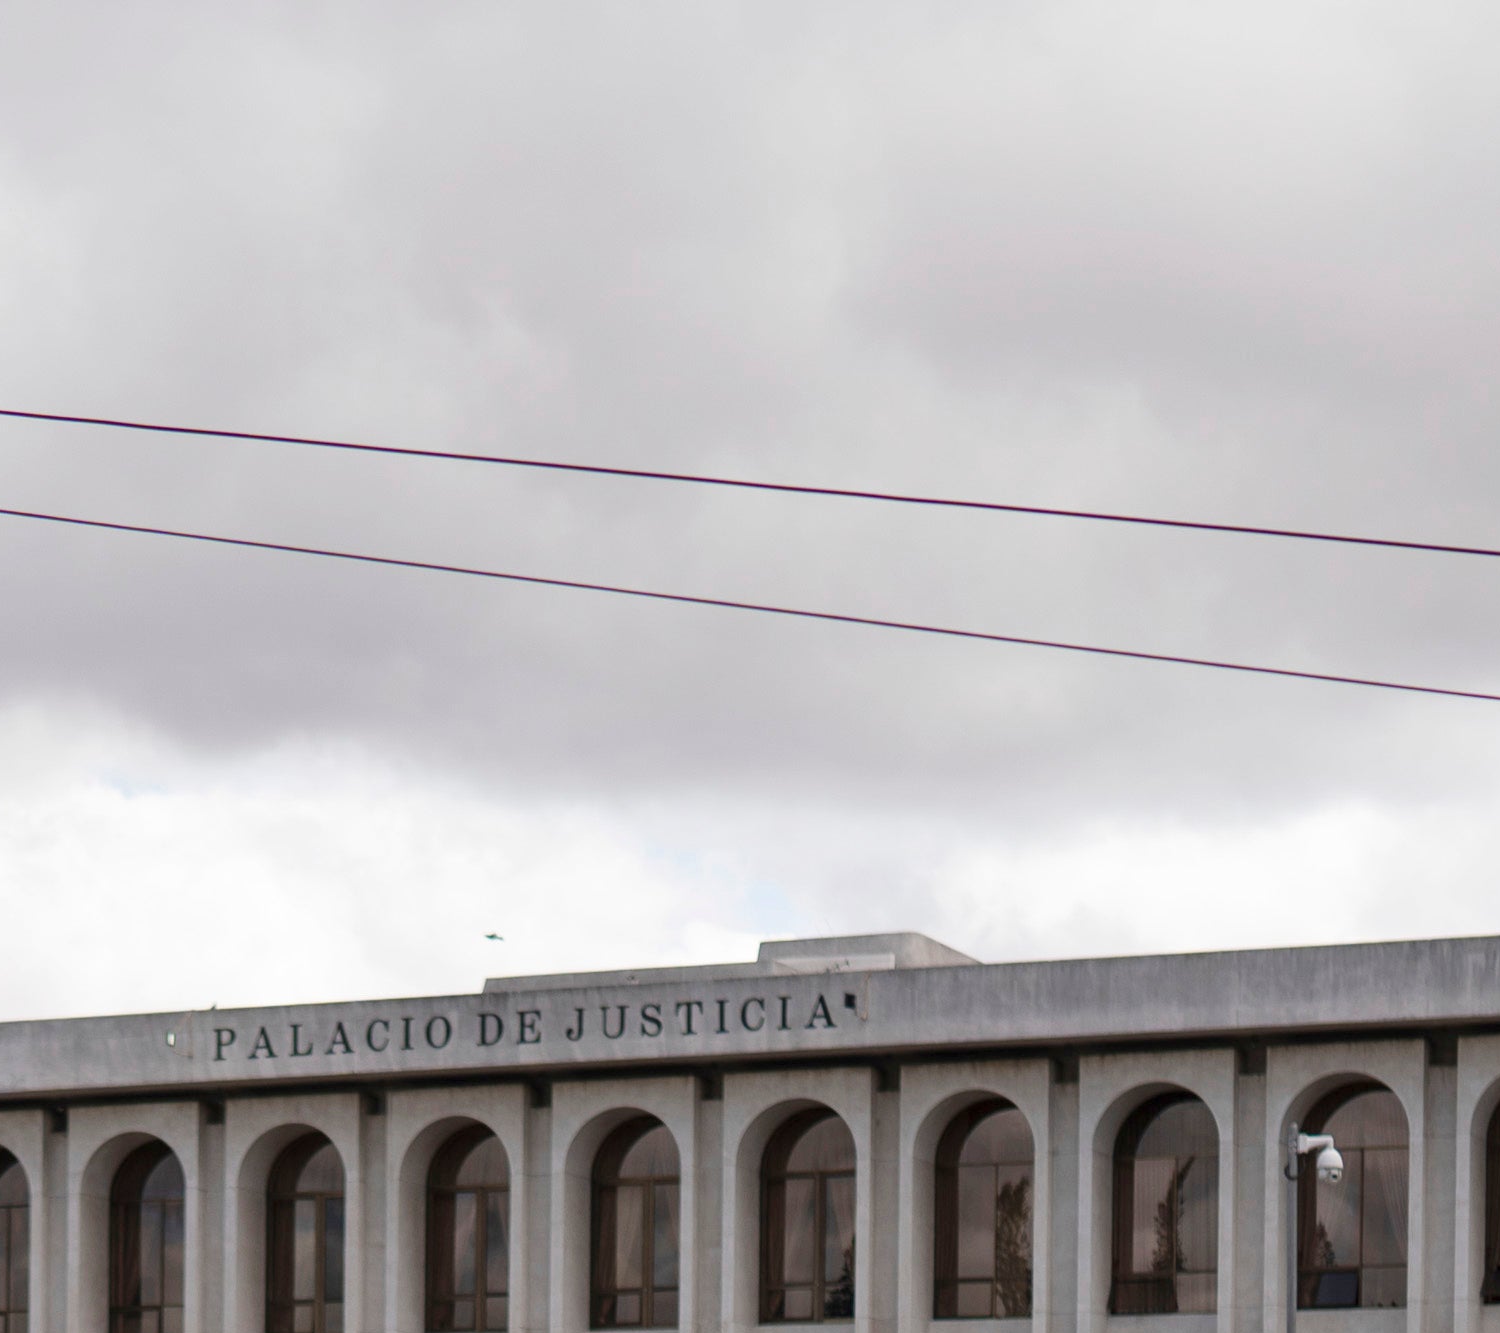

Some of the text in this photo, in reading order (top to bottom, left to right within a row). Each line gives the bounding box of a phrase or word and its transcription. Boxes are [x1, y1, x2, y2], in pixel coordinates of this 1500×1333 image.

[212, 994, 839, 1062] PALACIO DE JUSTICIA
